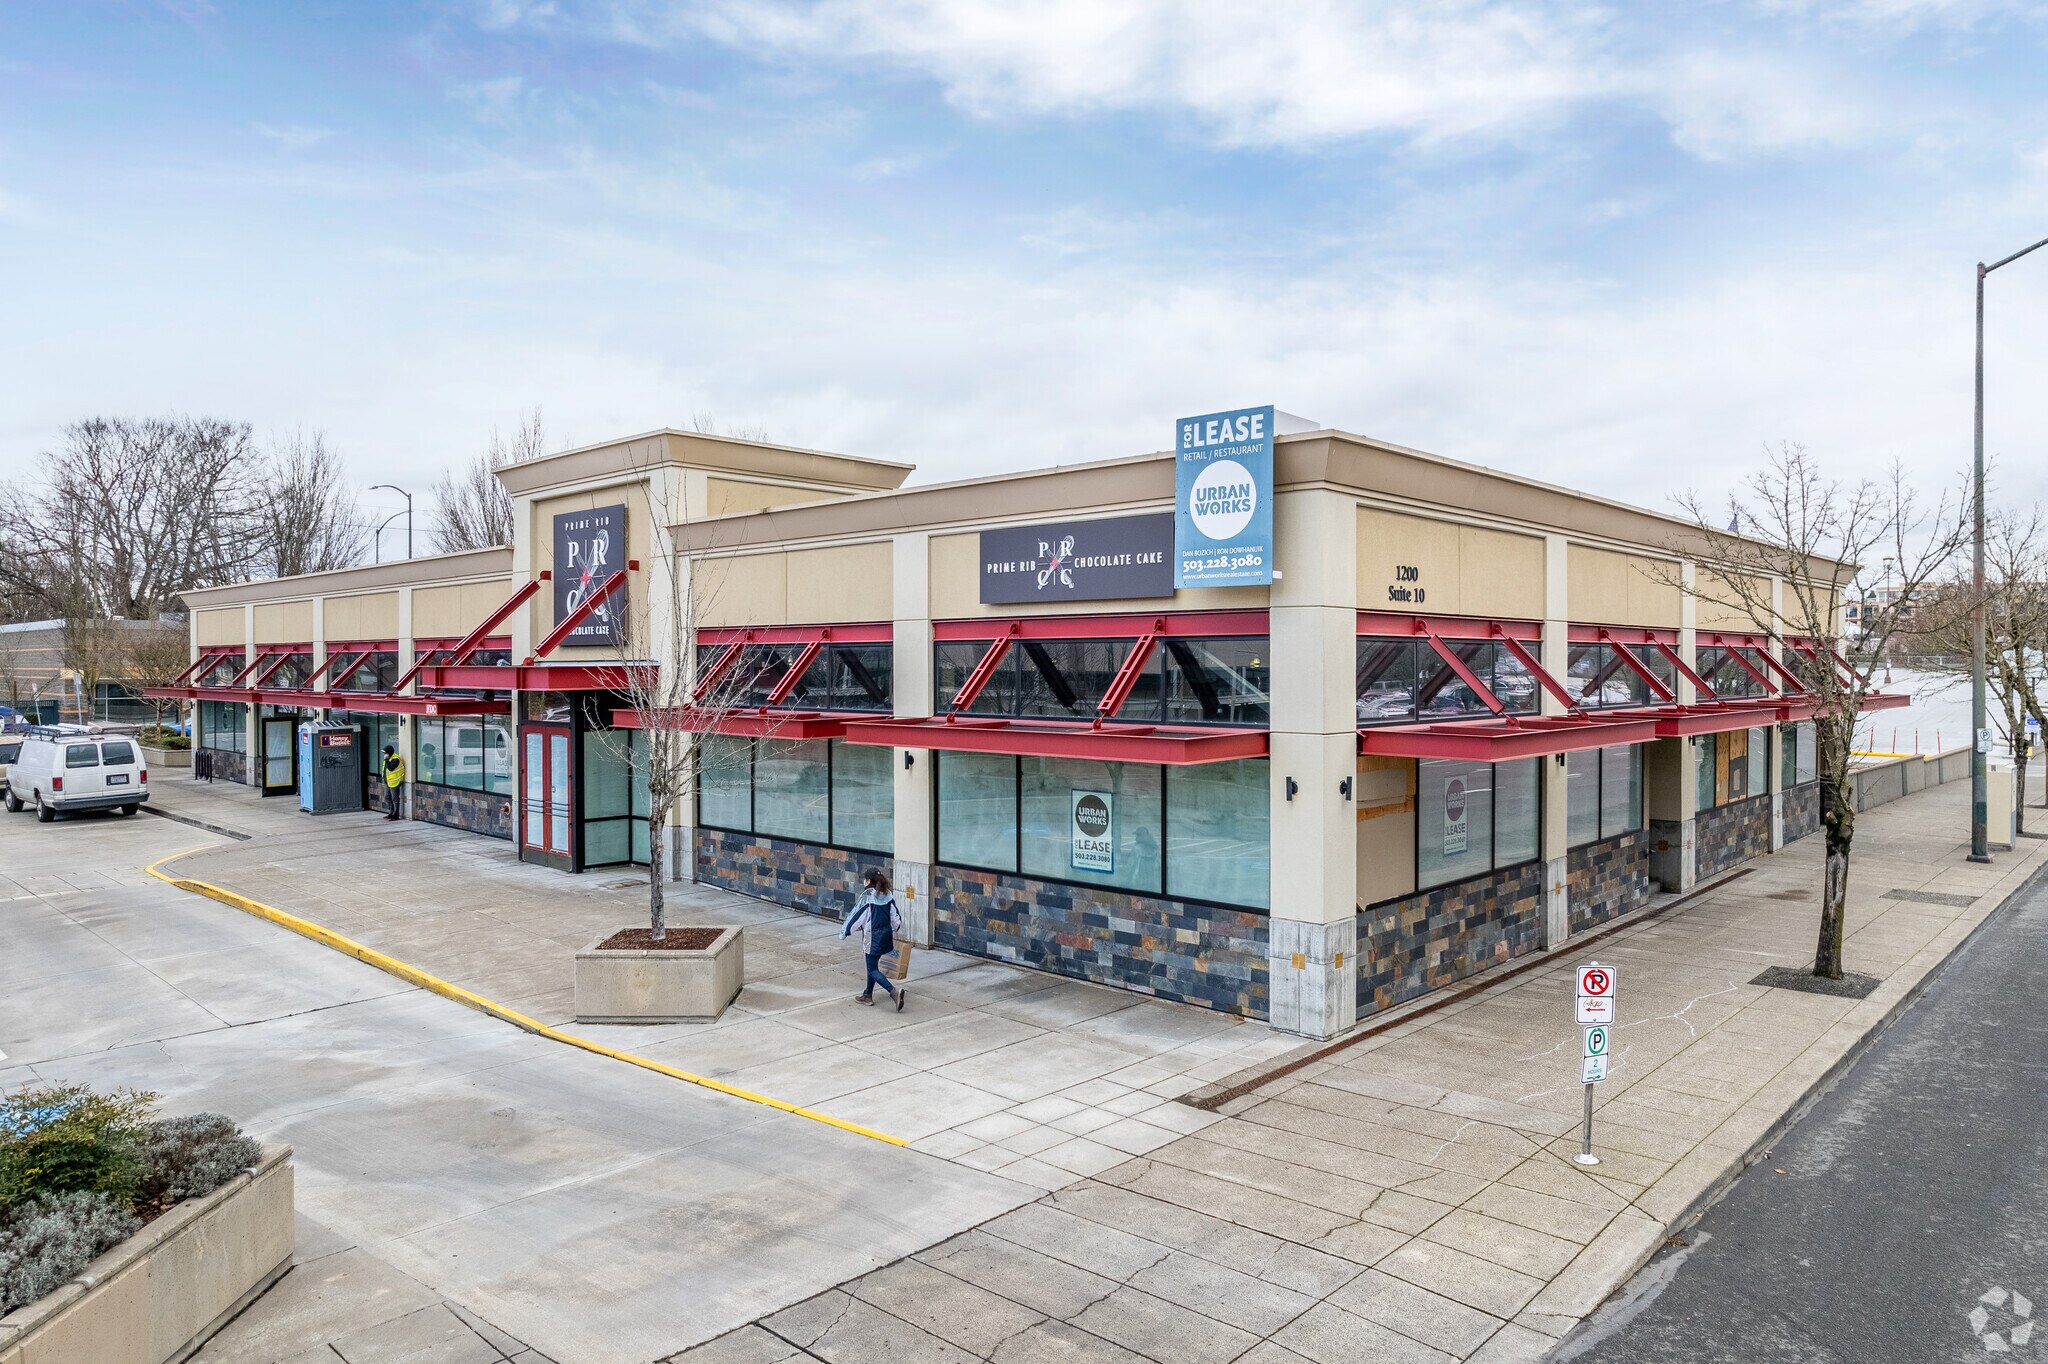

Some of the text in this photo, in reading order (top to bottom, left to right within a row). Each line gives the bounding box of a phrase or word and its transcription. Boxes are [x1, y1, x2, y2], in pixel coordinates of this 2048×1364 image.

[1183, 413, 1264, 448] FOR LEASE
[1183, 451, 1207, 461] RETAIL
[1214, 443, 1264, 457] RESTAURANT
[1196, 483, 1250, 501] URBAN
[1195, 498, 1251, 516] WORKS
[565, 516, 610, 531] PRIME RIB
[567, 539, 607, 568] P R
[1038, 540, 1073, 558] P R
[987, 552, 1163, 574] PRIME RIB CHOCOLATE CAKE
[1183, 554, 1262, 573] 503.228.3080
[1396, 565, 1419, 582] 1200
[1388, 585, 1425, 603] Suite 10
[1078, 806, 1107, 818] URBAN
[1078, 815, 1107, 826] WORKS
[1447, 822, 1466, 836] LEASE
[1078, 839, 1110, 853] LEASE
[1074, 852, 1110, 863] 503.228.3080
[1593, 1033, 1602, 1050] P
[1593, 1059, 1599, 1068] 2
